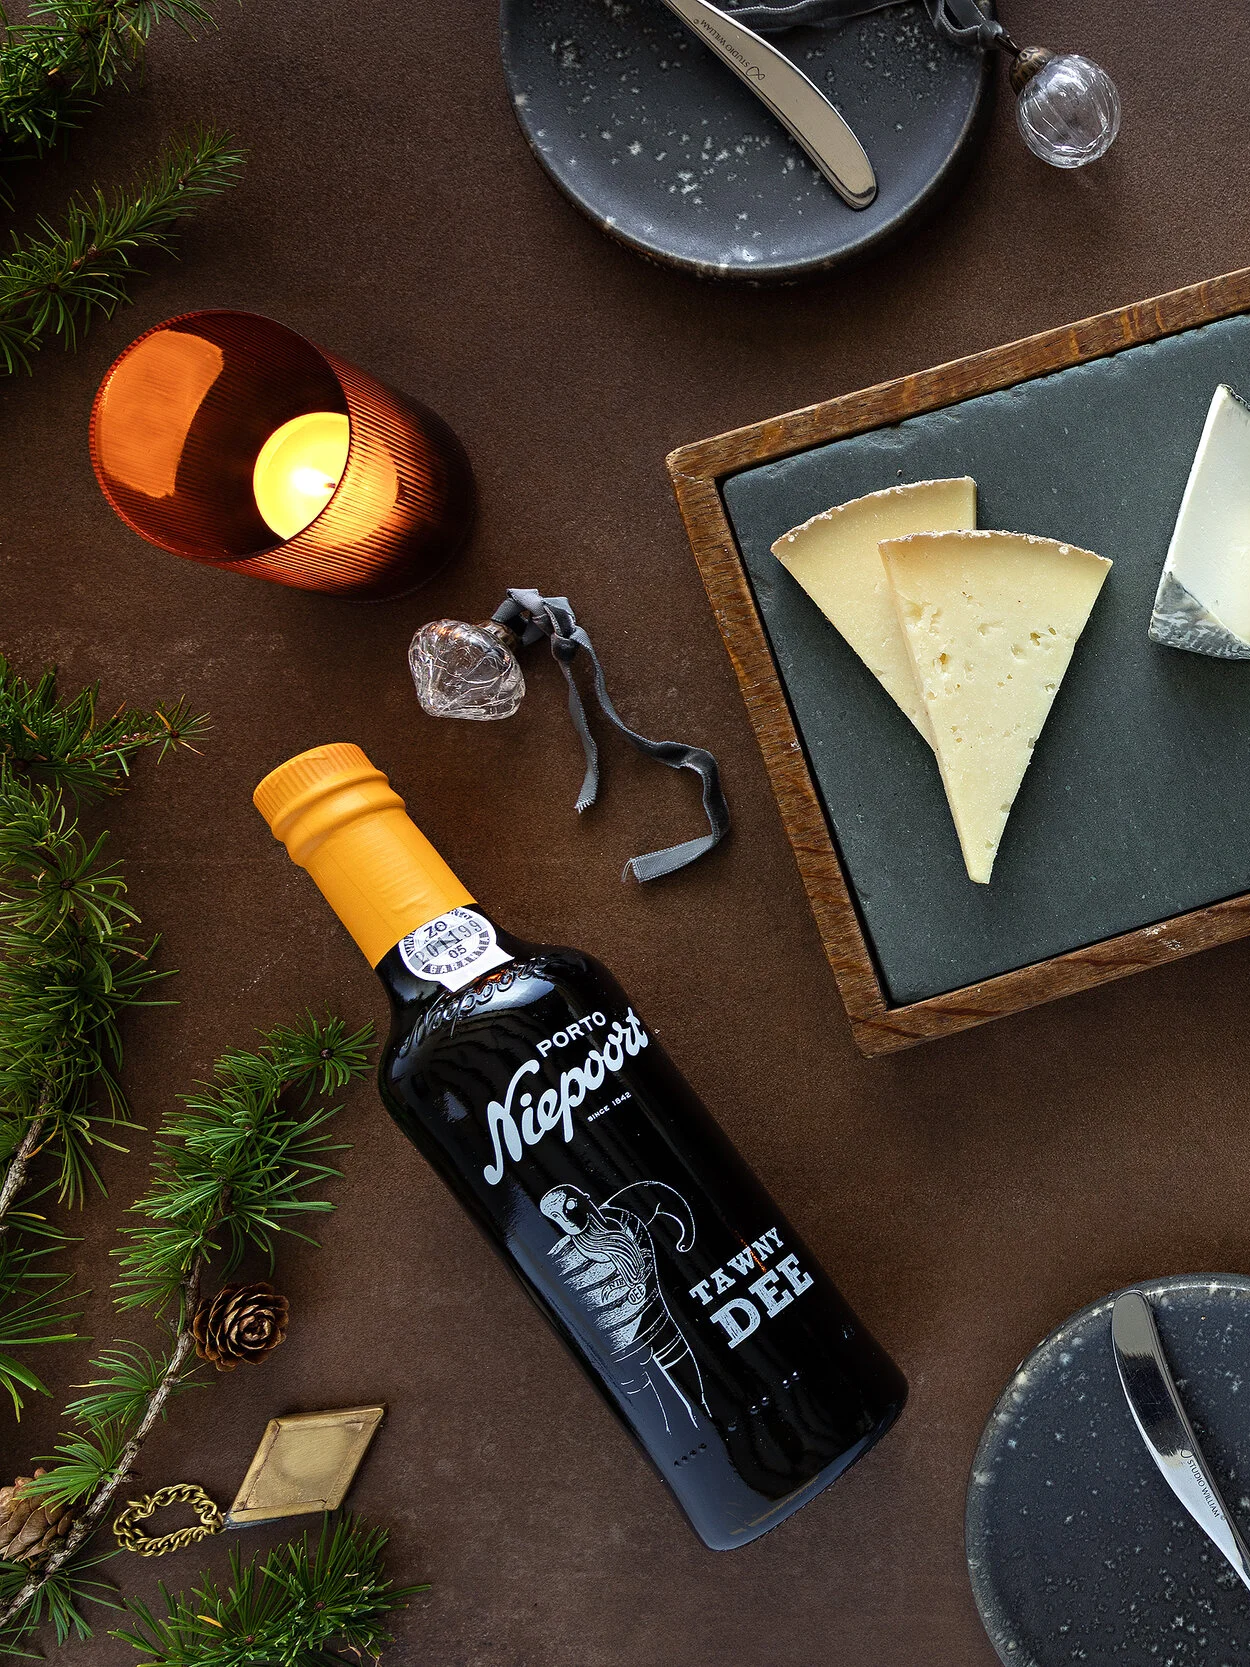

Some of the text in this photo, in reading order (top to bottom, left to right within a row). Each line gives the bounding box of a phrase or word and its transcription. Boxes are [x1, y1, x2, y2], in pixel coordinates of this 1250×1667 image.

[725, 44, 750, 68] STUDIO
[414, 919, 483, 966] 201199
[448, 944, 467, 959] 05
[535, 1011, 607, 1058] PORTO
[483, 1006, 649, 1186] Niepoort
[587, 1091, 632, 1122] SINCE 1842
[688, 1226, 785, 1306] TAWNY
[709, 1252, 815, 1350] DEE
[1186, 1459, 1205, 1487] STUDIO
